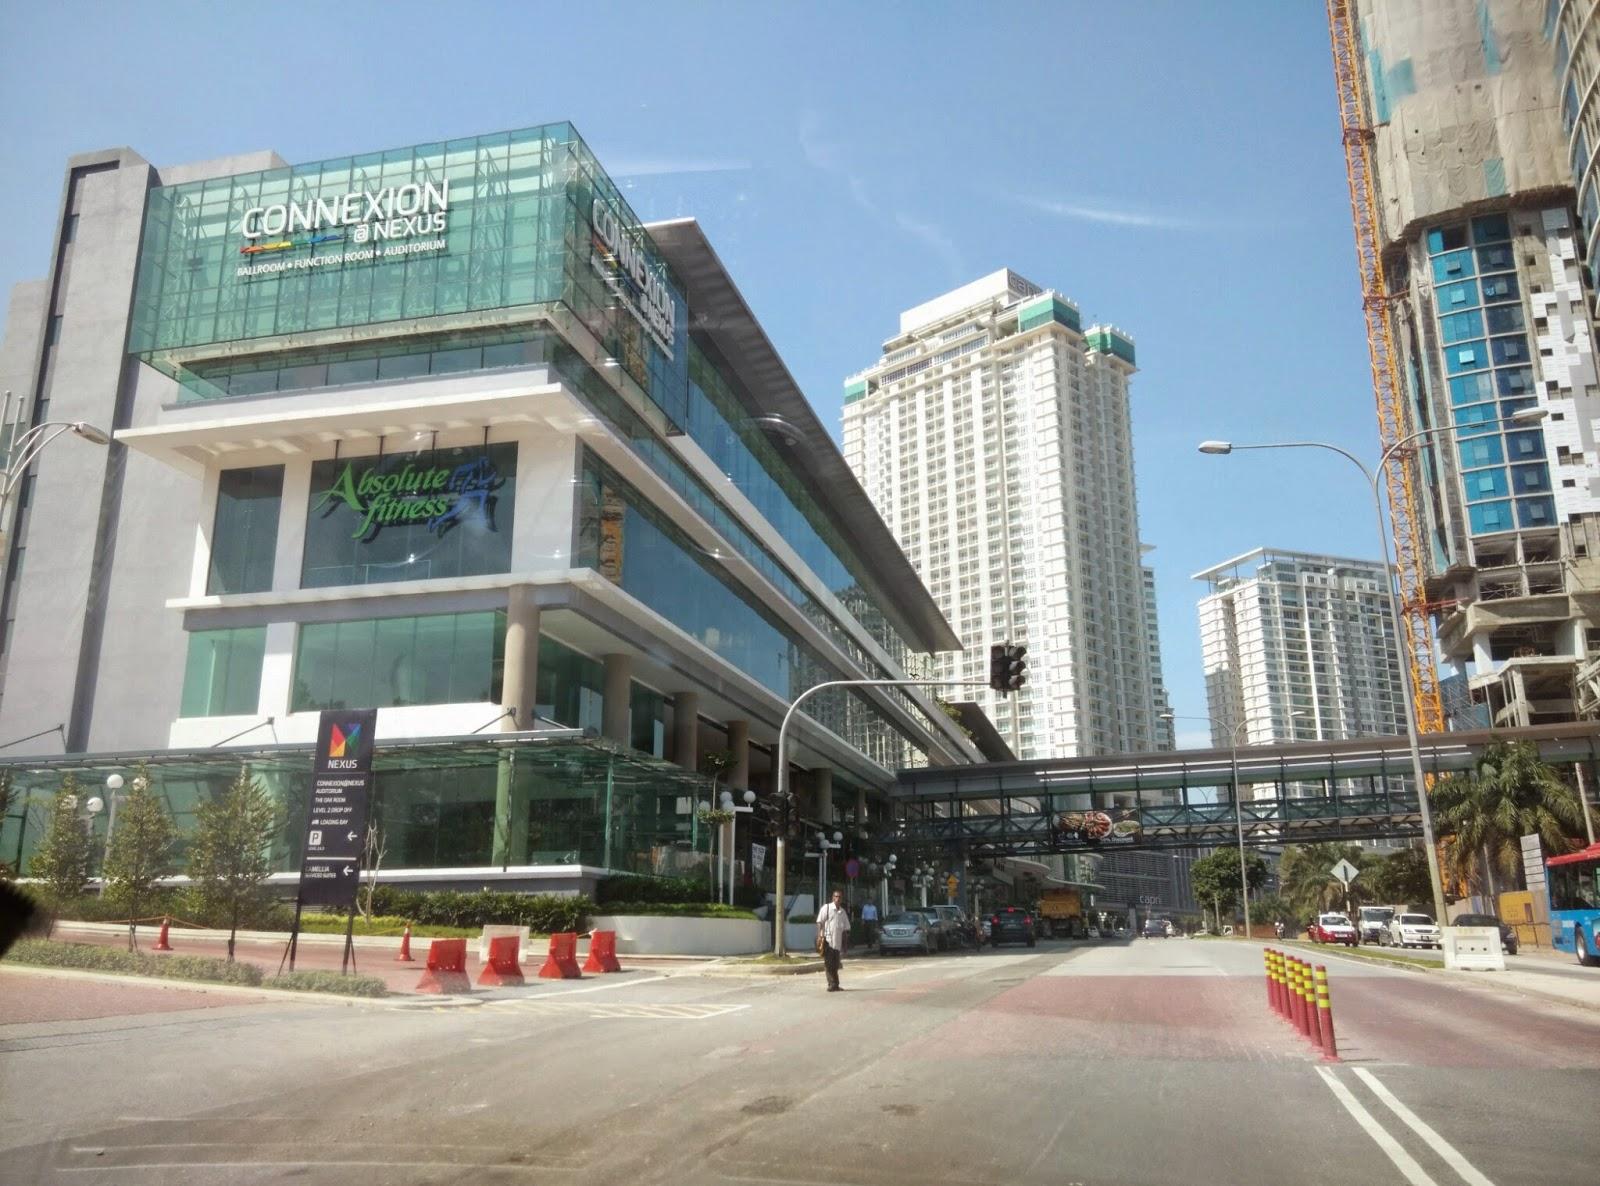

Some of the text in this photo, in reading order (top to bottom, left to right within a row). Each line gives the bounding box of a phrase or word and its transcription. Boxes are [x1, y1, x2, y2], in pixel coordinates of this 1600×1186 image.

[241, 178, 449, 239] CONNEXION
[353, 211, 446, 243] @ NEXUS
[237, 239, 446, 276] BALLROOM FUNCTION ROOM AUDITORIUM
[592, 199, 675, 333] CONNEXION
[313, 462, 450, 512] Absolute
[352, 491, 449, 539] fitness
[327, 759, 358, 769] NEXUS
